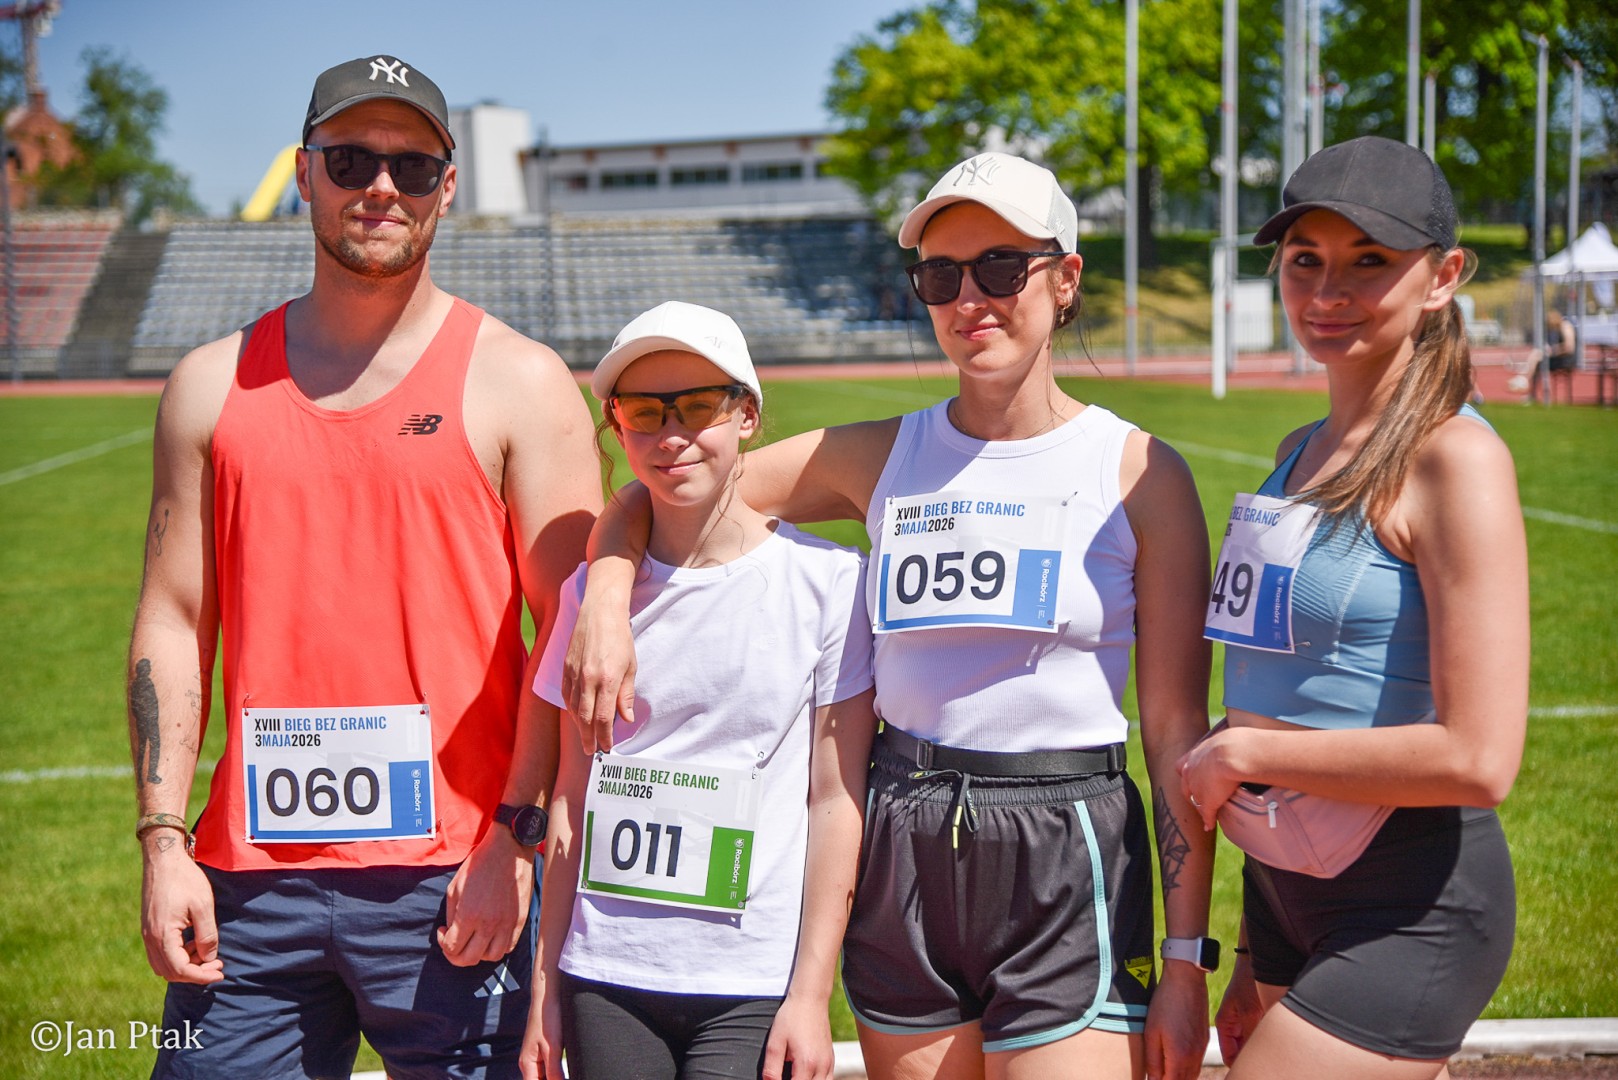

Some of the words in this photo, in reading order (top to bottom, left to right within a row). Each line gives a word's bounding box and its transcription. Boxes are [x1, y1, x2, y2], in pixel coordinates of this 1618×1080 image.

[895, 506, 921, 521] XVIII
[923, 502, 948, 518] BIEG
[951, 500, 972, 515] BEZ
[976, 501, 1026, 517] GRANIC
[1244, 507, 1280, 527] GRANIC
[894, 517, 955, 536] 3MAJA2026
[896, 550, 1006, 605] 059
[1039, 568, 1050, 603] Racibórz
[254, 718, 281, 732] XVIII
[285, 718, 311, 732] BIEG
[315, 717, 336, 731] BEZ
[340, 716, 387, 731] GRANIC
[255, 734, 321, 747] 3MAJA2026
[597, 780, 653, 799] 3MAJA2026
[600, 764, 623, 780] XVIII
[624, 766, 647, 783] BIEG
[649, 770, 670, 785] BEZ
[673, 772, 720, 790] GRANIC
[266, 766, 380, 817] 060
[413, 779, 421, 812] Racibórz
[611, 819, 682, 878] 011
[731, 849, 742, 884] Racibórz
